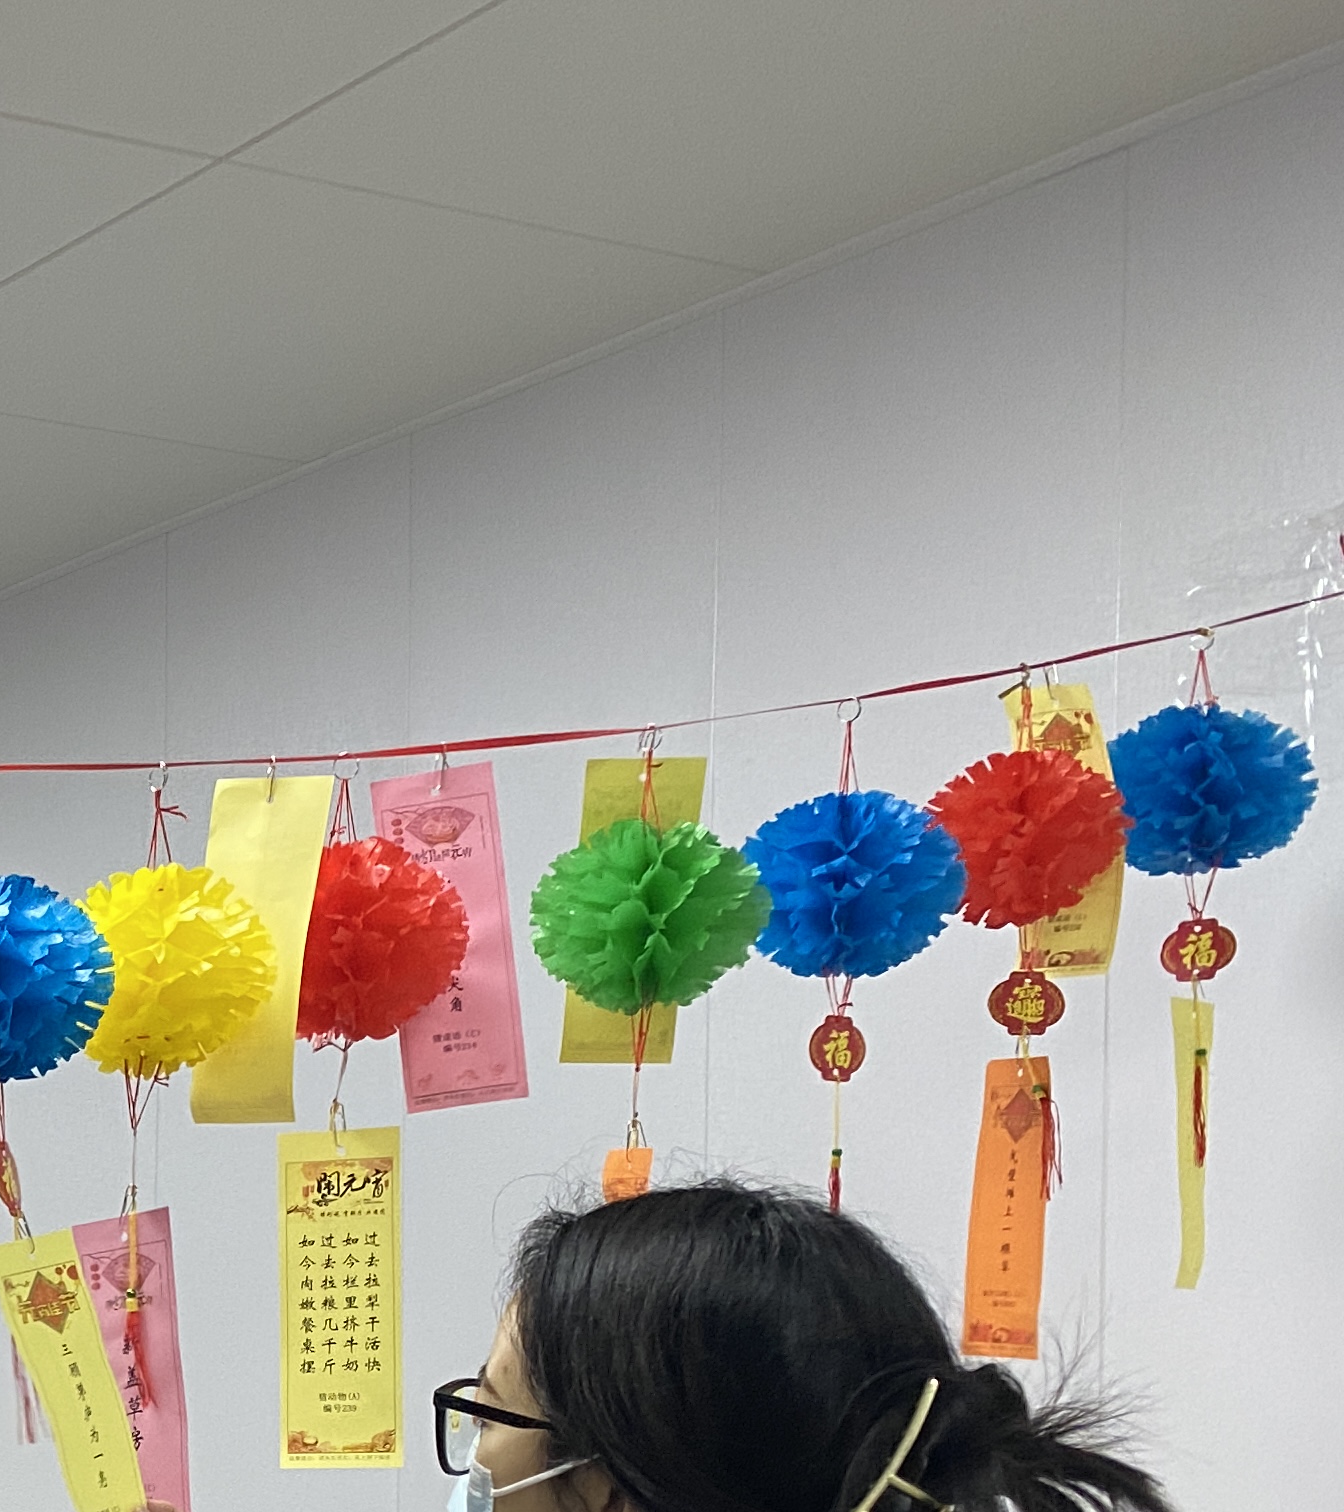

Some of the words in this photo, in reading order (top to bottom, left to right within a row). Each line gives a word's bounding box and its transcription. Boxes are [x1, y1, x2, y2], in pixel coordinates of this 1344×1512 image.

[1178, 931, 1217, 970] 福
[823, 1030, 851, 1068] 福
[316, 1169, 388, 1199] 闹元宵
[298, 1235, 316, 1373] 如今肉嫩餐桌摆
[320, 1234, 338, 1375] 过去拉粮几千斤
[342, 1233, 359, 1373] 如今栏里挤牛奶
[363, 1232, 381, 1372] 过去拉犁干活快
